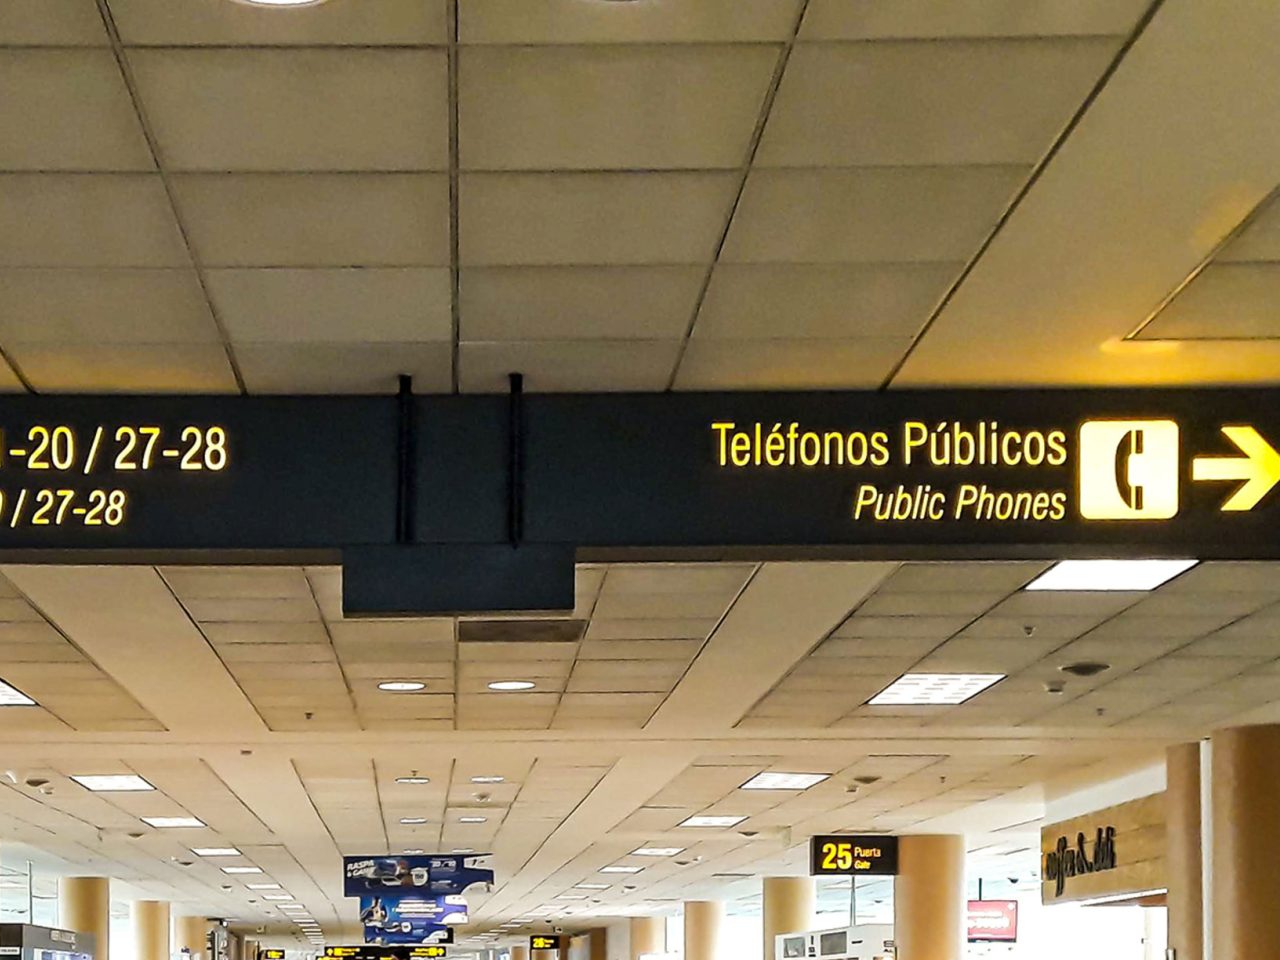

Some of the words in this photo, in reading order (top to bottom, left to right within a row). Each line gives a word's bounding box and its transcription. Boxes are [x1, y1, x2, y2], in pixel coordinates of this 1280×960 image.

[83, 426, 103, 474] /
[114, 426, 227, 471] 27-28
[711, 422, 890, 467] Teléfonos
[904, 421, 1067, 467] Públicos
[10, 489, 26, 528] /
[32, 489, 126, 526] 27-28
[854, 484, 946, 521] Public
[955, 484, 1067, 521] Phones
[821, 843, 853, 870] 25
[854, 846, 881, 858] Puerta
